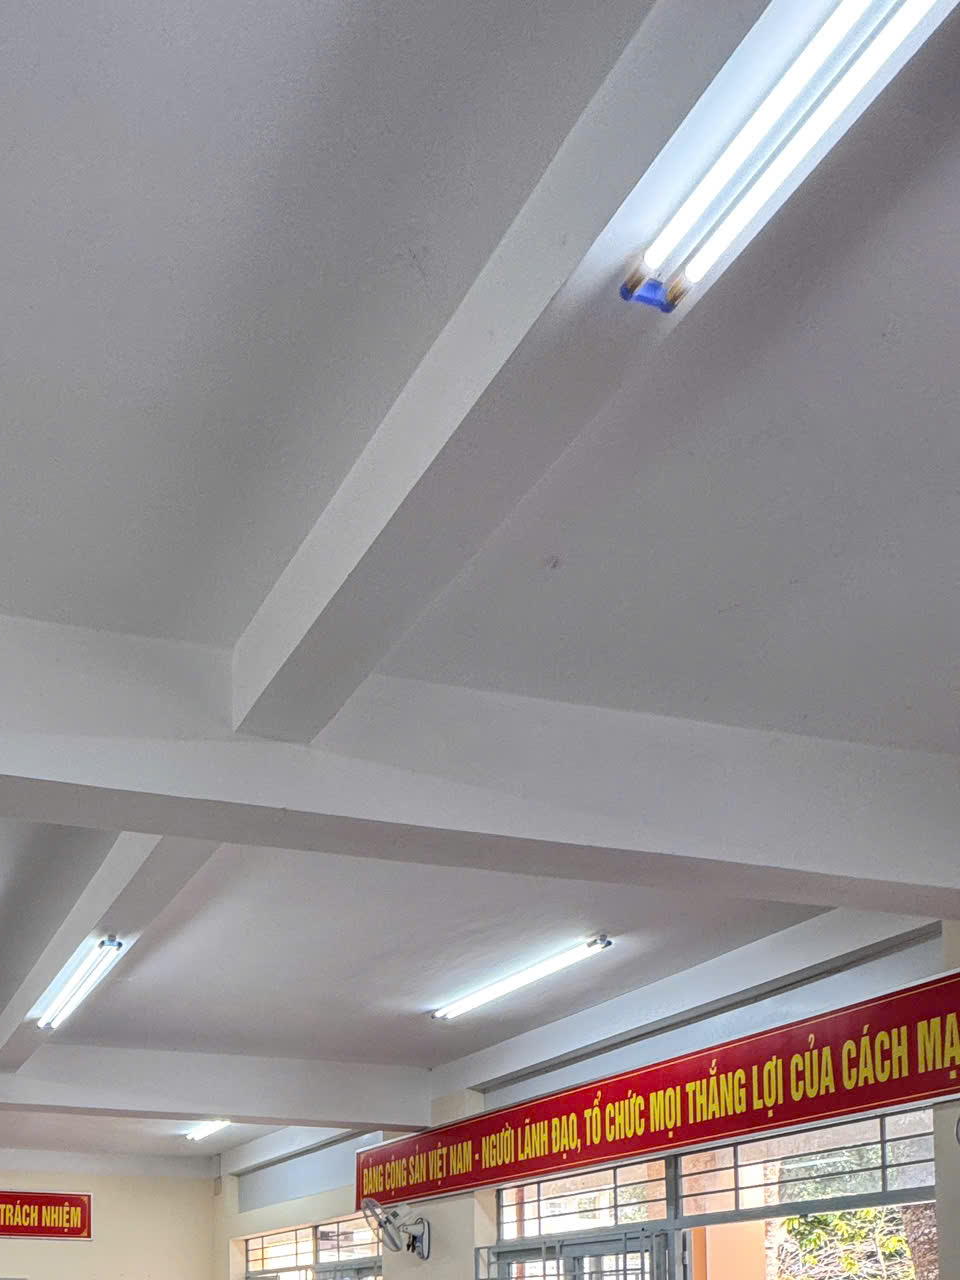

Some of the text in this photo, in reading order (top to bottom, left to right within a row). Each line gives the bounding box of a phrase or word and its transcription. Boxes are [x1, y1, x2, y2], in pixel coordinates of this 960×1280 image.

[363, 1158, 384, 1196] ĐẢNG
[385, 1155, 407, 1196] CỘNG
[408, 1144, 427, 1185] SẢN
[428, 1142, 448, 1185] VIỆT
[449, 1140, 473, 1176] NAM
[481, 1122, 515, 1169] NGƯỜI
[517, 1118, 548, 1161] LÃNH
[551, 1112, 581, 1159] ĐẠO,
[584, 1090, 601, 1146] TỔ
[605, 1089, 645, 1143] CHỨC
[649, 1085, 682, 1138] MỌI
[685, 1058, 747, 1125] THẮNG
[752, 1055, 784, 1118] LỢI
[790, 1033, 835, 1102] CỦA
[841, 1024, 909, 1090] CÁCH
[0, 1200, 39, 1227] TRÁCH
[41, 1202, 82, 1233] NHIỆM
